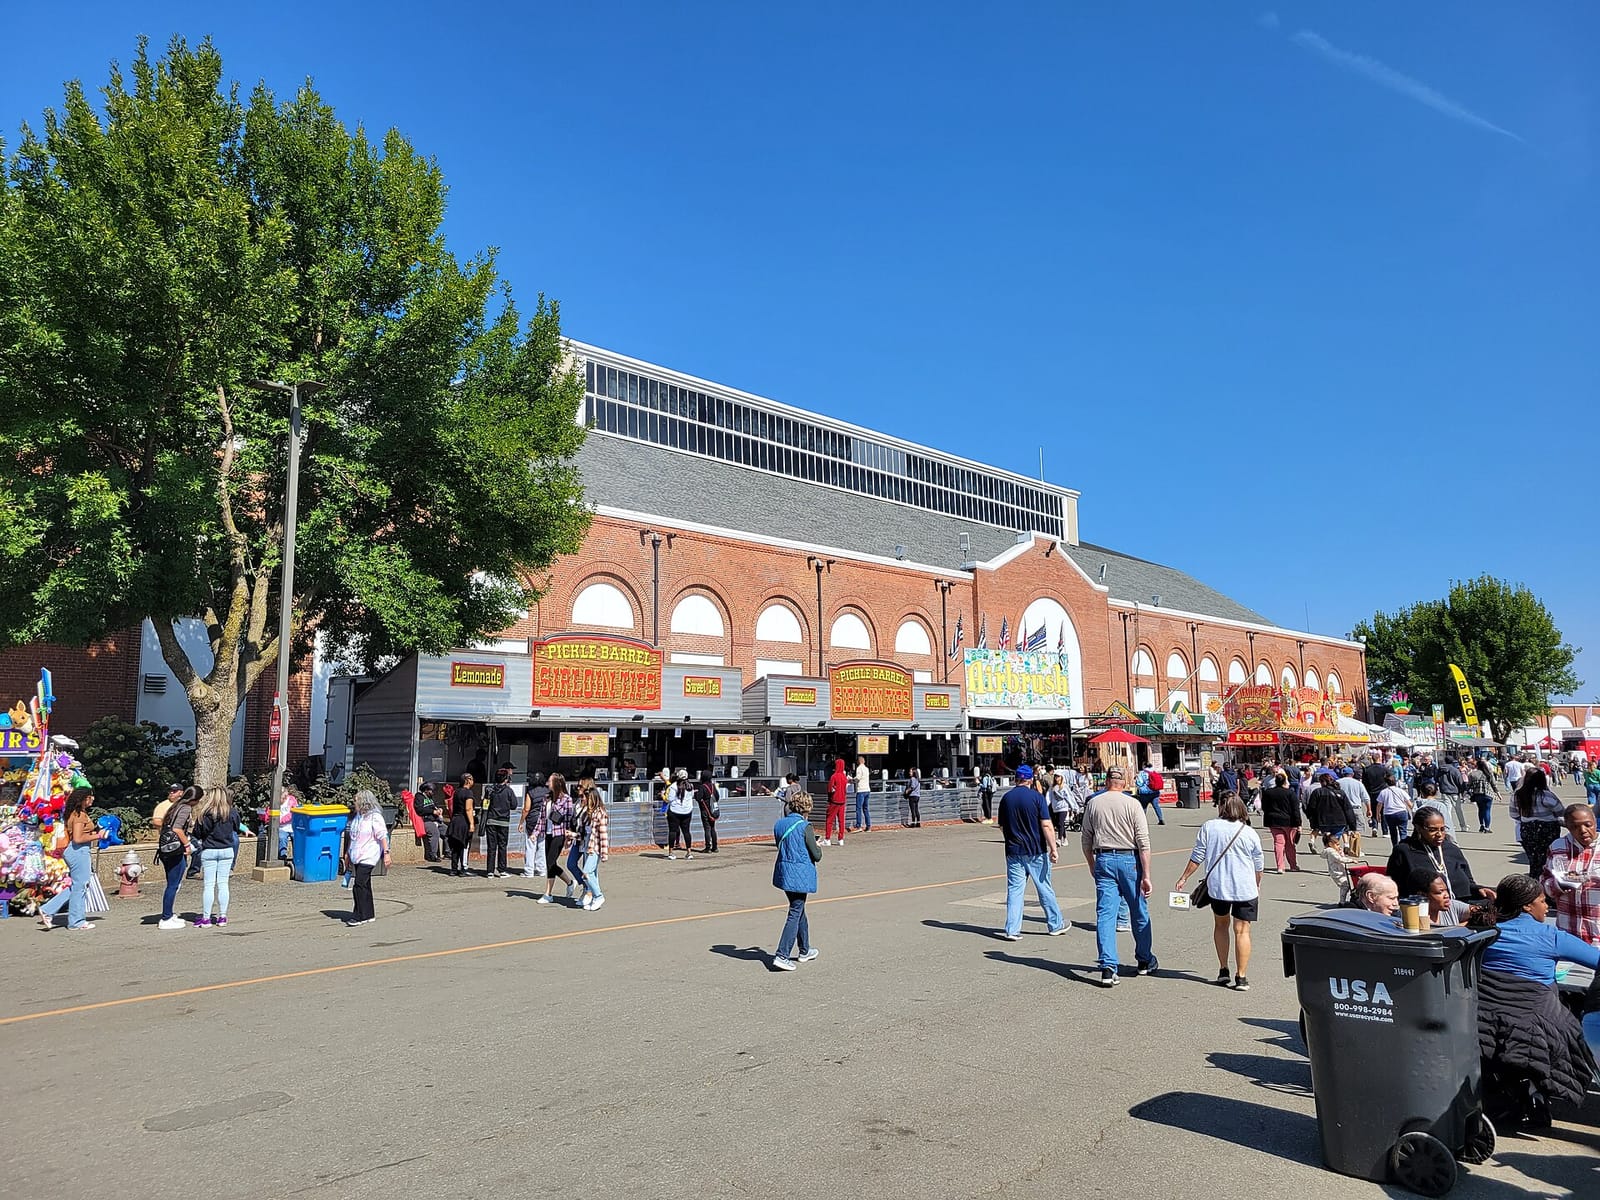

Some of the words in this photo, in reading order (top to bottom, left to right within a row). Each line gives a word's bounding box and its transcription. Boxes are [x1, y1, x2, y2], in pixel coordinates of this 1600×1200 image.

[547, 644, 597, 660] PICKLE
[600, 645, 651, 666] BARREL
[455, 665, 502, 685] Lemonade
[539, 666, 616, 698] SIRLOIN
[620, 670, 657, 700] TIPS
[685, 678, 707, 694] Sweet
[708, 679, 720, 694] Tea
[839, 668, 871, 682] PICKLE
[873, 668, 906, 686] BARREL
[967, 660, 1069, 696] Airbrush
[834, 686, 884, 713] SIRLOIN
[885, 688, 911, 715] TIPS
[1458, 680, 1476, 717] BBQ
[1235, 733, 1273, 742] FRIES
[1329, 977, 1393, 1005] USA
[1334, 1003, 1392, 1016] 800-998-2984
